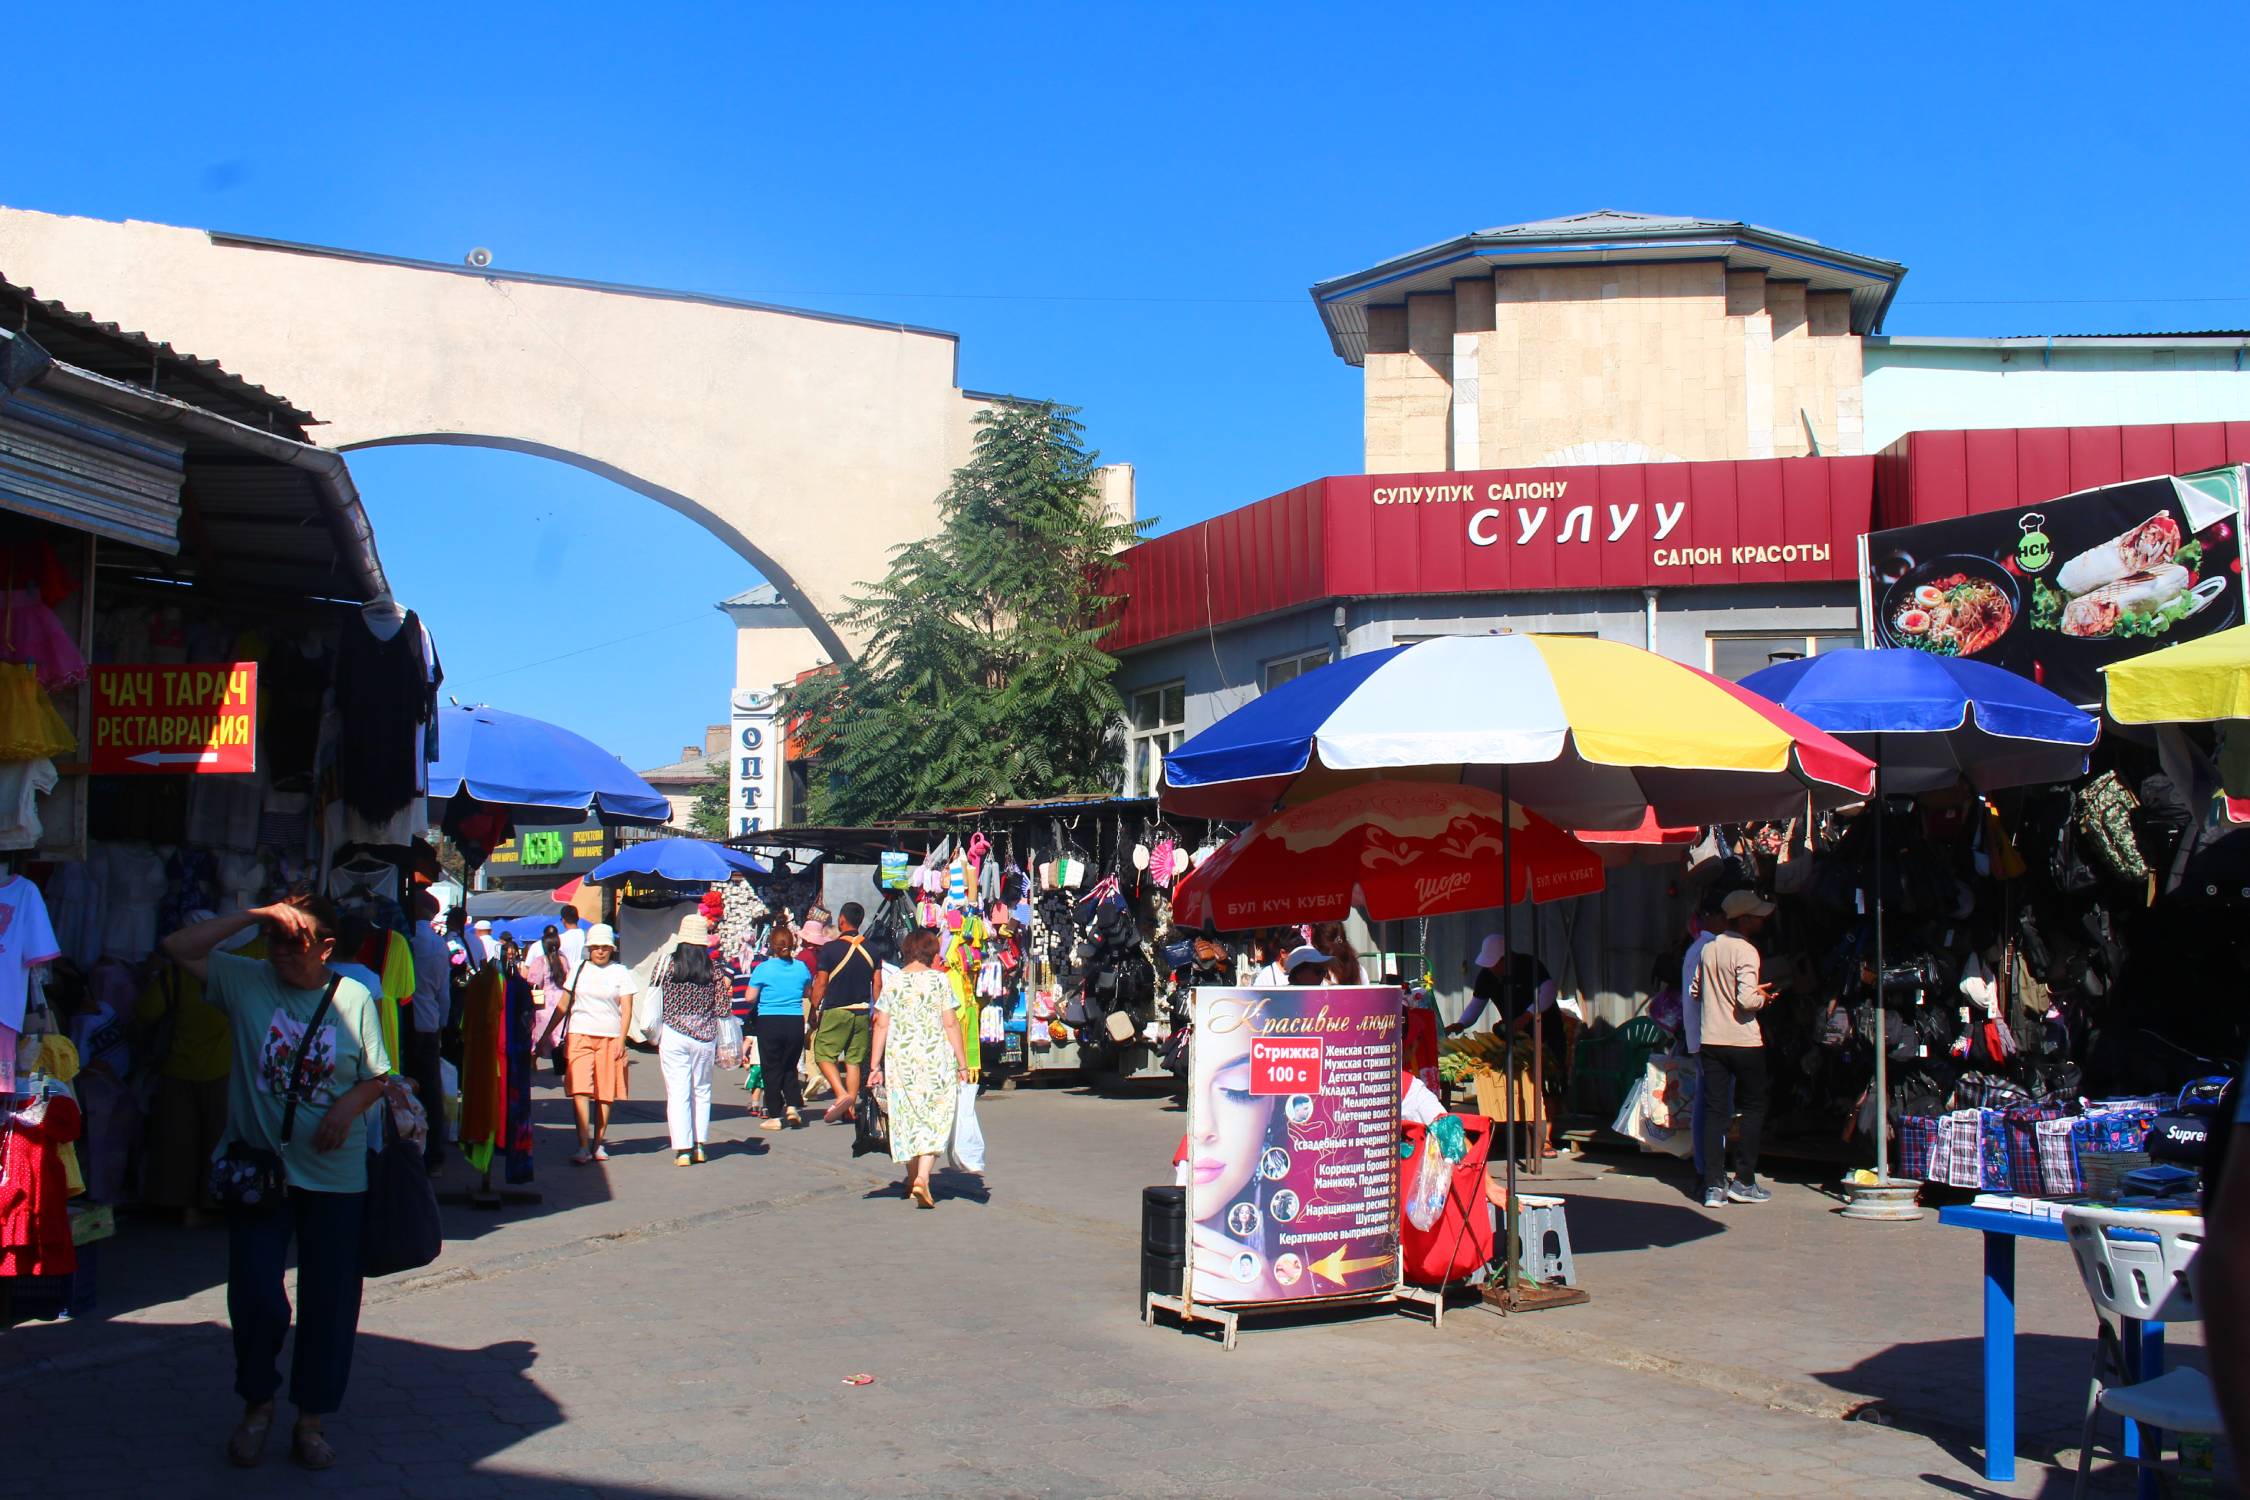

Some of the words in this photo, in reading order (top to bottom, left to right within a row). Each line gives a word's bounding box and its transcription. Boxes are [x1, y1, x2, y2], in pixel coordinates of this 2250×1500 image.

[1373, 485, 1474, 505] СУЛУУЛУК
[1488, 481, 1568, 501] САЛОНУ
[1468, 502, 1685, 546] СУЛУУ
[1653, 547, 1722, 566] САЛОН
[1732, 544, 1830, 564] КРАСОТЫ
[100, 672, 153, 706] ЧАЧ
[162, 671, 248, 706] ТАРАЧ
[97, 715, 249, 750] РЕСТАВРАЦИЯ
[1227, 902, 1256, 915] БУЛ
[1298, 893, 1345, 908] КУБАТ
[1208, 998, 1349, 1036] Красивые
[1356, 1013, 1397, 1039] люди
[1254, 1043, 1319, 1062] Стрижка
[1326, 1045, 1362, 1056] Женская
[1364, 1044, 1390, 1056] стрижка
[1324, 1058, 1361, 1071] Мужская
[1267, 1067, 1294, 1082] 100
[1298, 1070, 1307, 1082] с
[1328, 1072, 1361, 1084] Детская
[1363, 1070, 1390, 1082] стрижка
[1321, 1085, 1358, 1097] Укладка,
[1360, 1083, 1390, 1095] Покраска
[1343, 1095, 1390, 1108] Мелирование
[1334, 1110, 1372, 1121] Плетение
[1373, 1109, 1390, 1120] волос
[1359, 1122, 1390, 1133] Прически
[1294, 1138, 1347, 1152] (свадебные
[1356, 1132, 1390, 1146] вечерние)
[1364, 1147, 1389, 1159] Макияж
[1319, 1162, 1365, 1176] Коррекция
[1366, 1158, 1389, 1171] бровей
[1315, 1177, 1357, 1189] Маникюр,
[1359, 1172, 1389, 1186] Педикюр
[1364, 1186, 1389, 1197] Шеллак
[1306, 1201, 1365, 1216] Наращивание
[1366, 1198, 1389, 1212] ресниц
[1355, 1211, 1389, 1225] Шугаринг
[1280, 1231, 1339, 1246] Кератиновое
[1340, 1223, 1389, 1240] выпрямление
